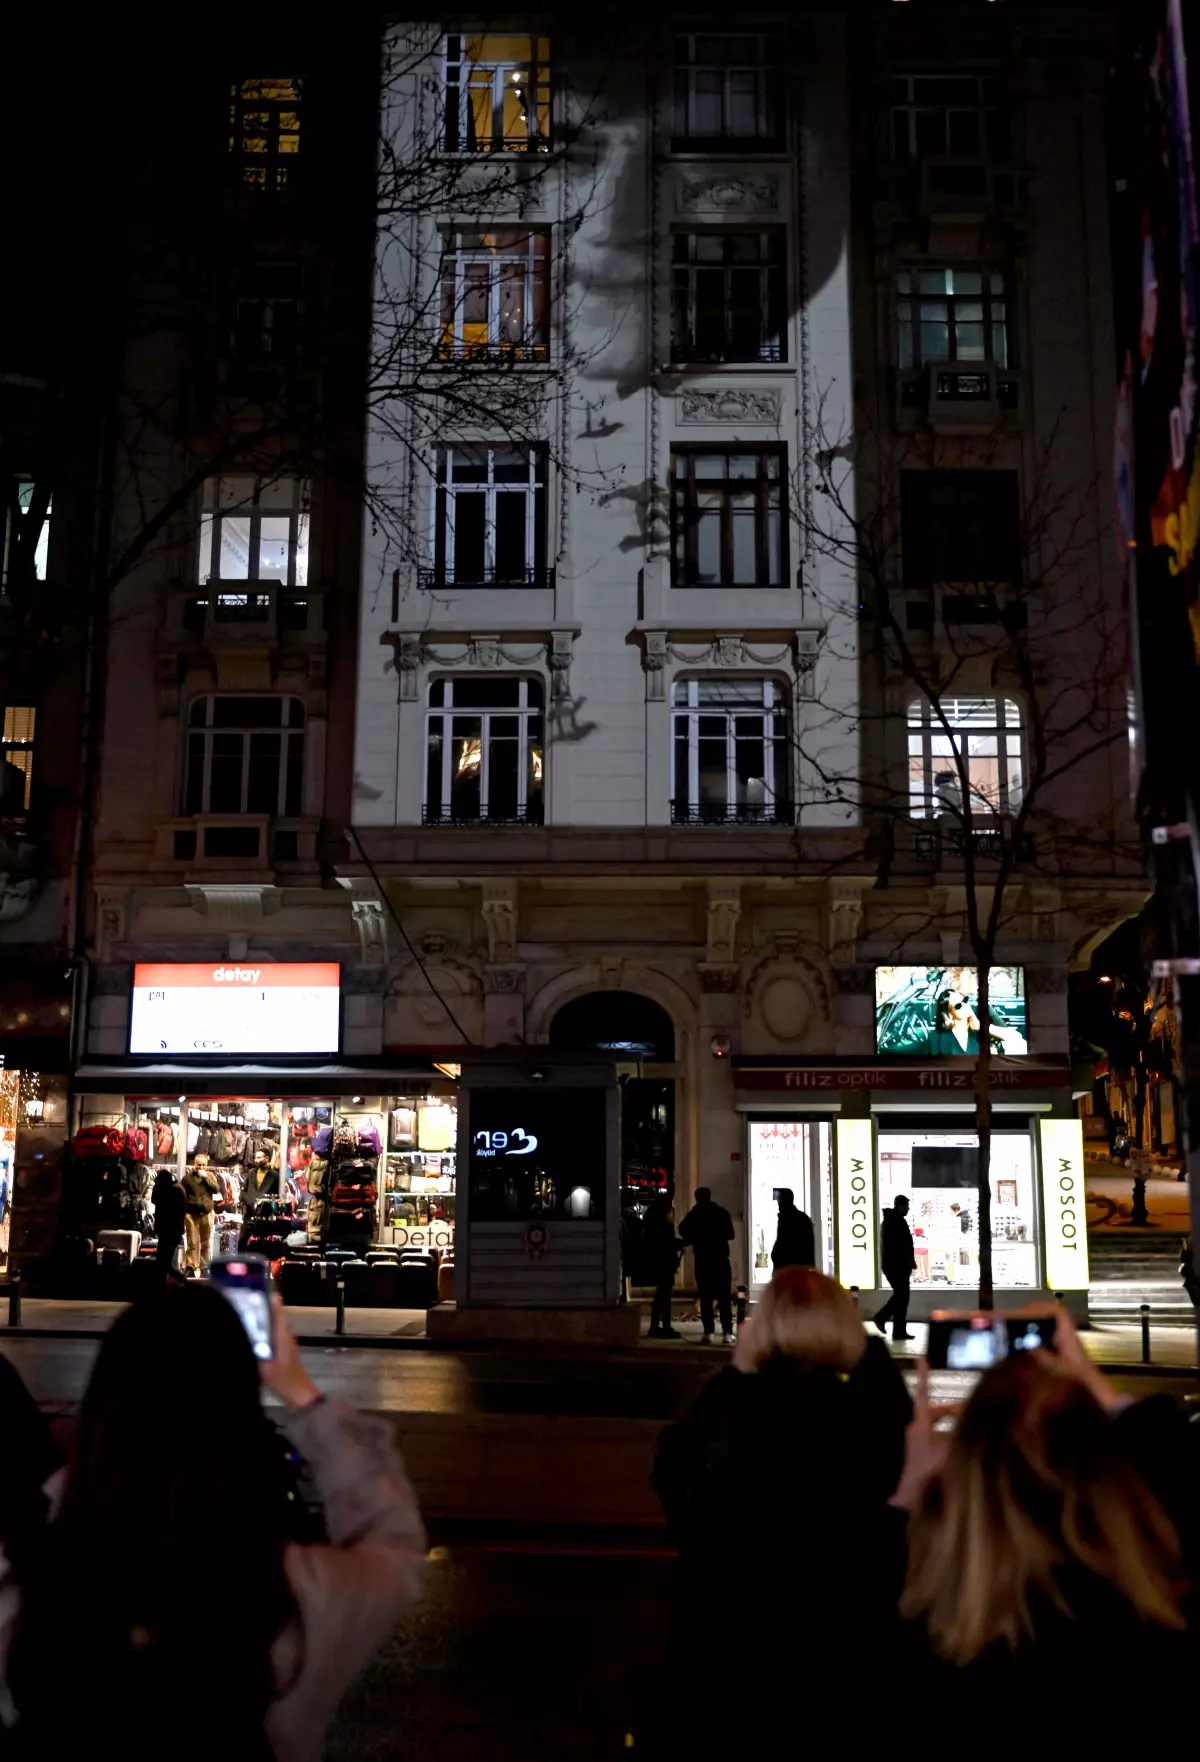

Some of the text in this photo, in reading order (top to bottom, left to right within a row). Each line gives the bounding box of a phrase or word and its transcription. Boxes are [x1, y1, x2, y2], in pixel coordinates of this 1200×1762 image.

[213, 966, 260, 985] detay
[785, 1071, 886, 1087] filiz optik
[918, 1071, 967, 1086] filiz
[850, 1158, 867, 1251] MOSCOT
[1058, 1158, 1077, 1251] MOSCOT
